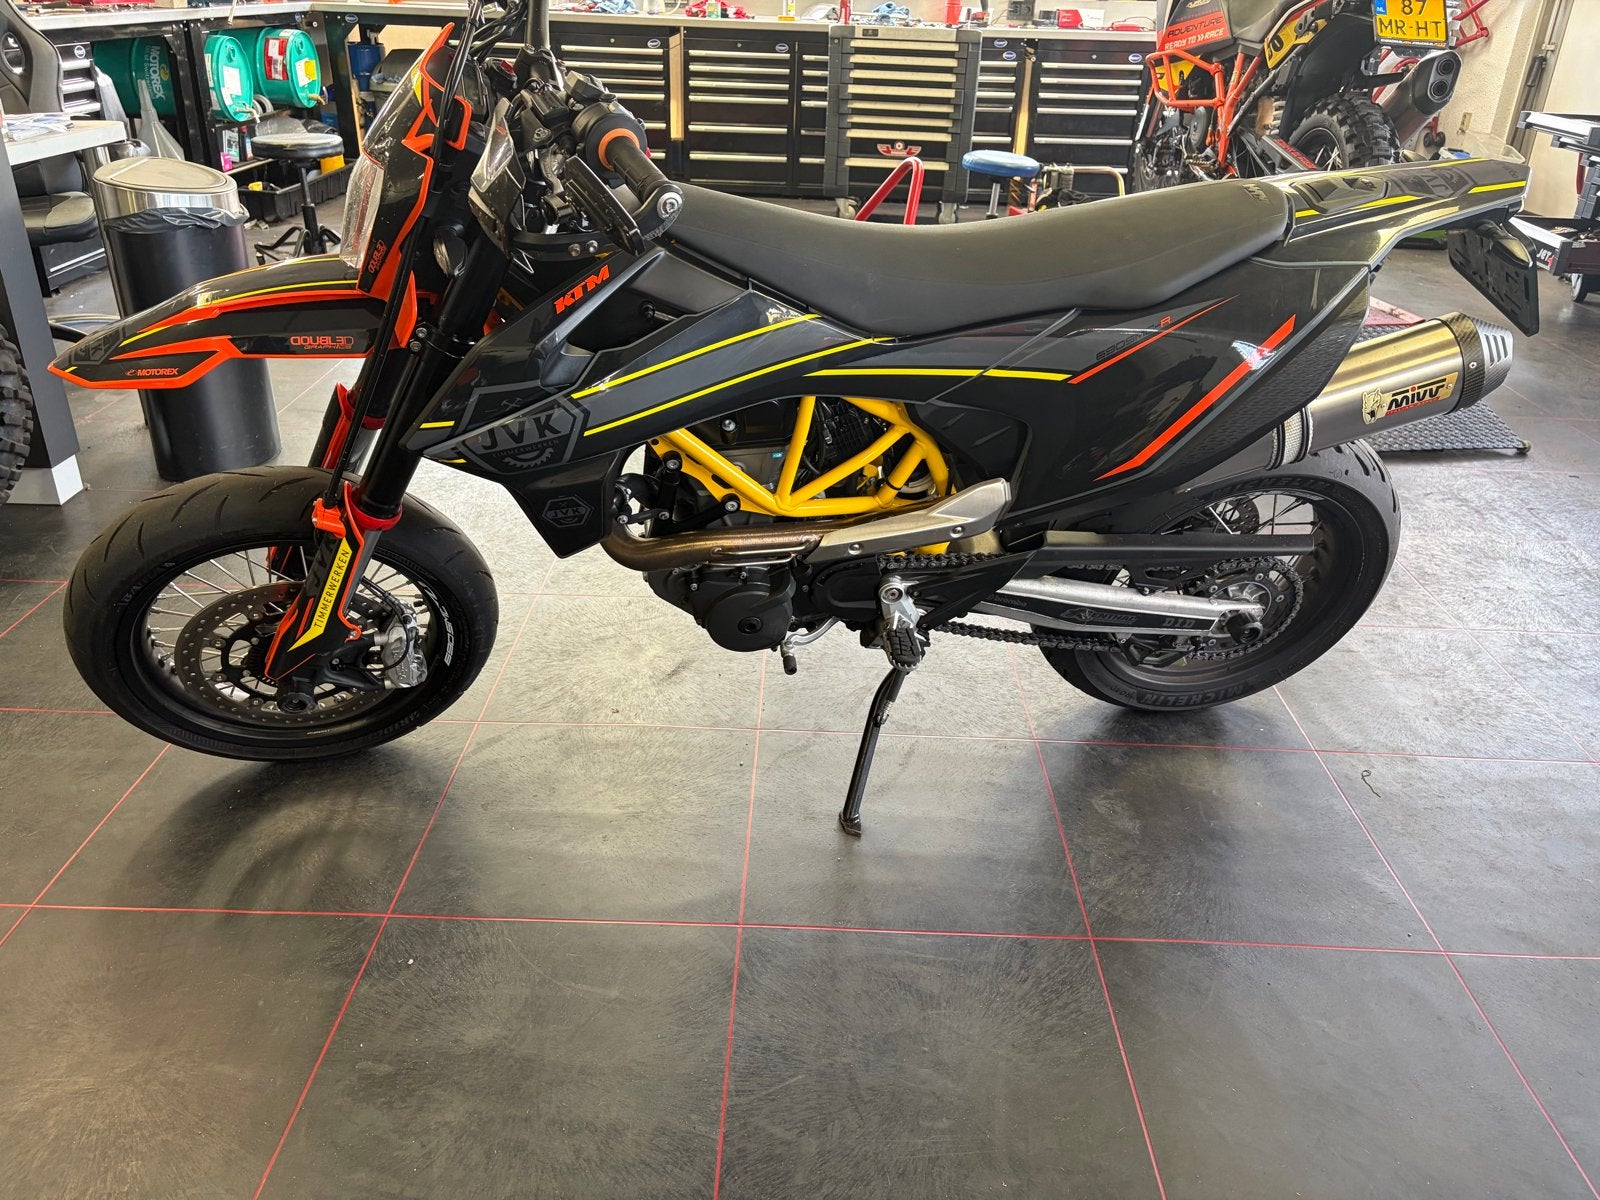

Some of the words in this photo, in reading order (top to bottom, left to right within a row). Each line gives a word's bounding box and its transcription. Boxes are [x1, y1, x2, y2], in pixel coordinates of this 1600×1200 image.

[1401, 0, 1427, 15] 87
[1378, 18, 1441, 37] MR-HT
[1164, 37, 1187, 50] READY
[1188, 35, 1197, 44] TO
[149, 45, 166, 100] MOTOREX
[553, 264, 610, 315] KTM
[137, 368, 179, 377] MOTOREX
[481, 412, 562, 450] JVK
[551, 507, 581, 517] JVK
[313, 549, 350, 628] TIMMERWERKEN
[1141, 684, 1245, 707] MICHELIN
